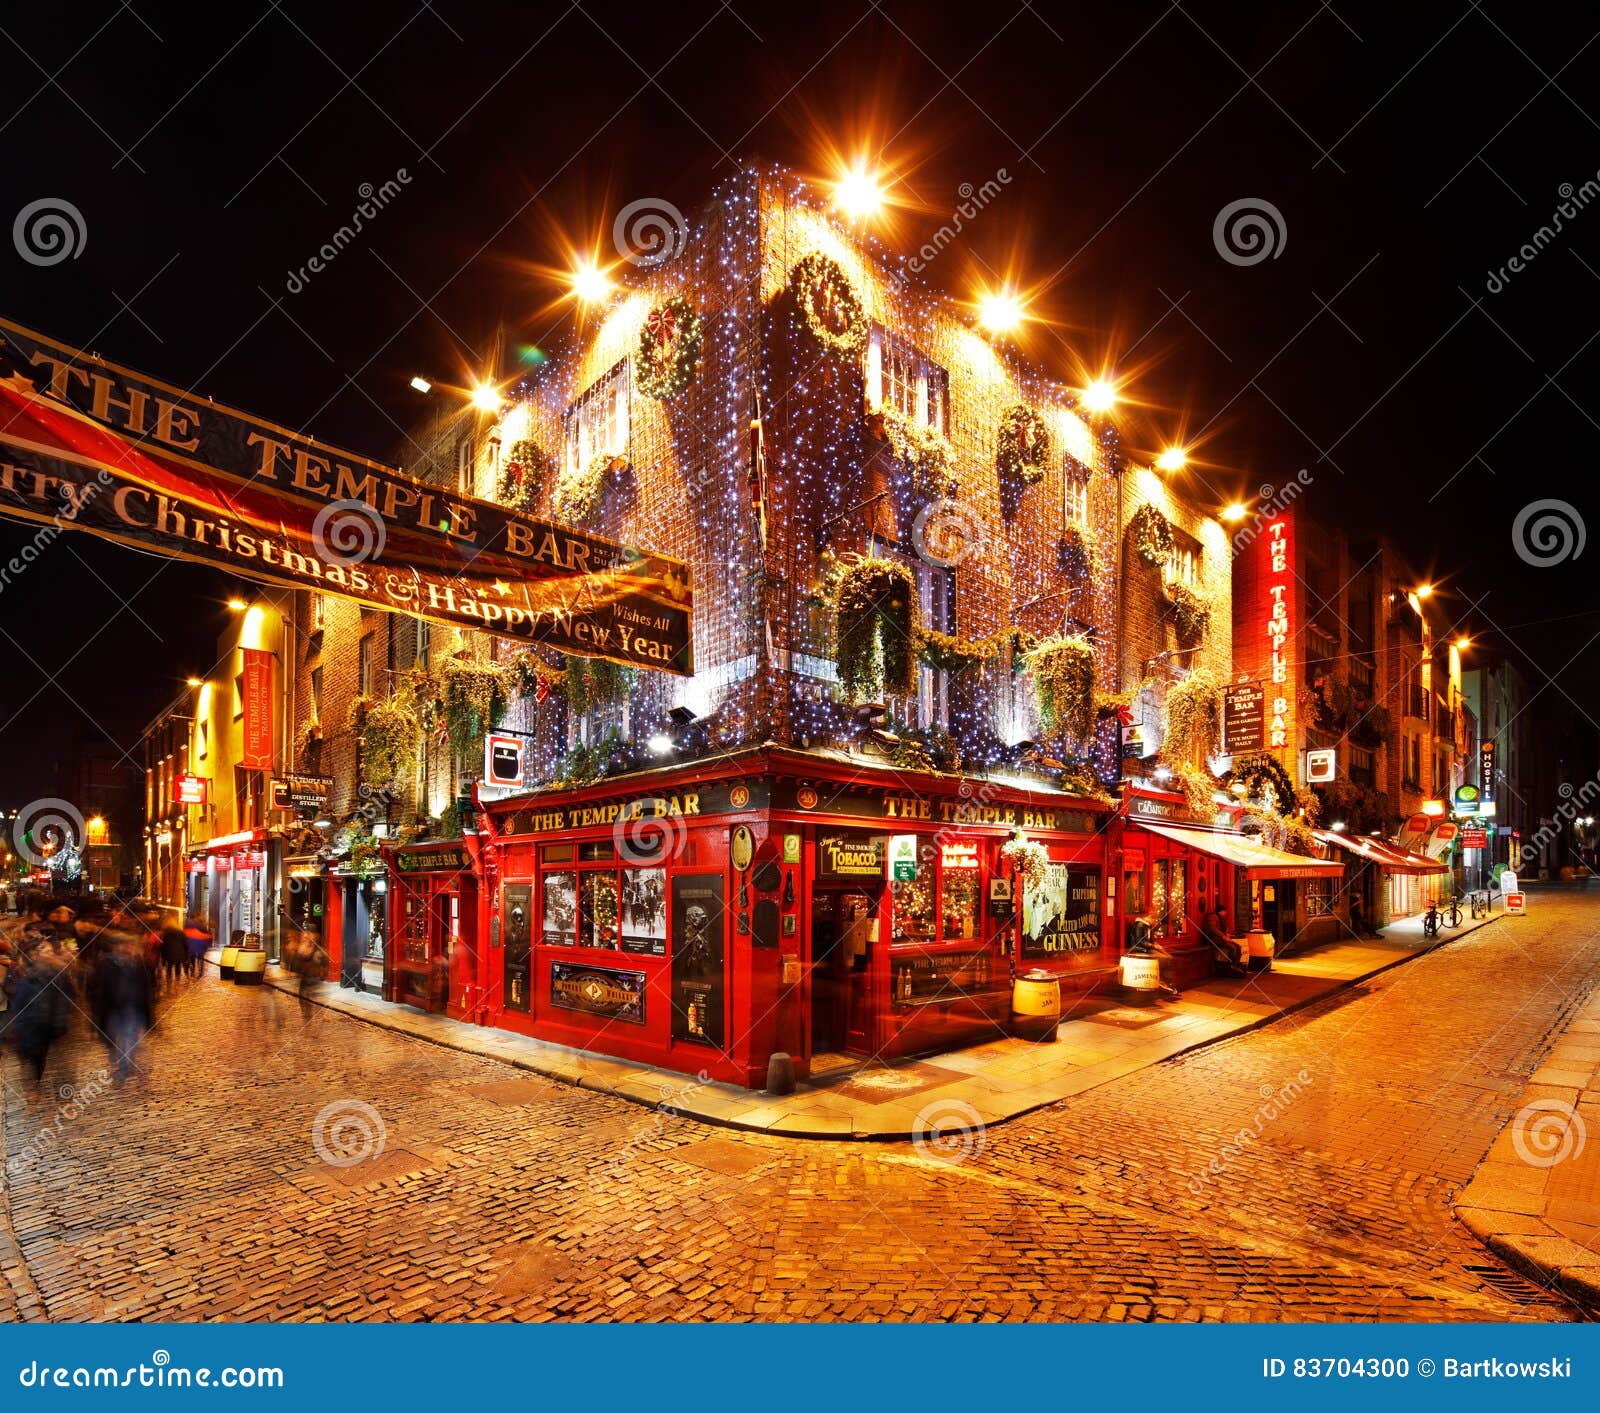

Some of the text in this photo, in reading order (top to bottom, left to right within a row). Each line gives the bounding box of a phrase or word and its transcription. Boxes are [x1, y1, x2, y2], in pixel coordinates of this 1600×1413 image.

[31, 351, 201, 452] THE
[247, 431, 479, 544] TEMPLE
[504, 519, 592, 574] BAR
[113, 485, 378, 592] Christmas
[427, 582, 543, 636] Happy
[551, 605, 611, 646] New
[615, 623, 674, 662] Year
[612, 602, 671, 632] Wishes All
[1267, 522, 1288, 747] THE TEMPLE BAR
[1226, 692, 1263, 704] TEMPLE
[1234, 702, 1254, 711] BAR
[1483, 753, 1492, 799] HOSTEL
[291, 794, 327, 802] DISTILLERY
[532, 792, 700, 832] THE TEMPLE BAR
[883, 797, 1056, 830] THE TEMPLE BAR
[419, 855, 443, 867] TEMPLE
[443, 853, 459, 866] BAR
[827, 847, 877, 871] TOBACCO
[1043, 931, 1099, 952] GUINNESS
